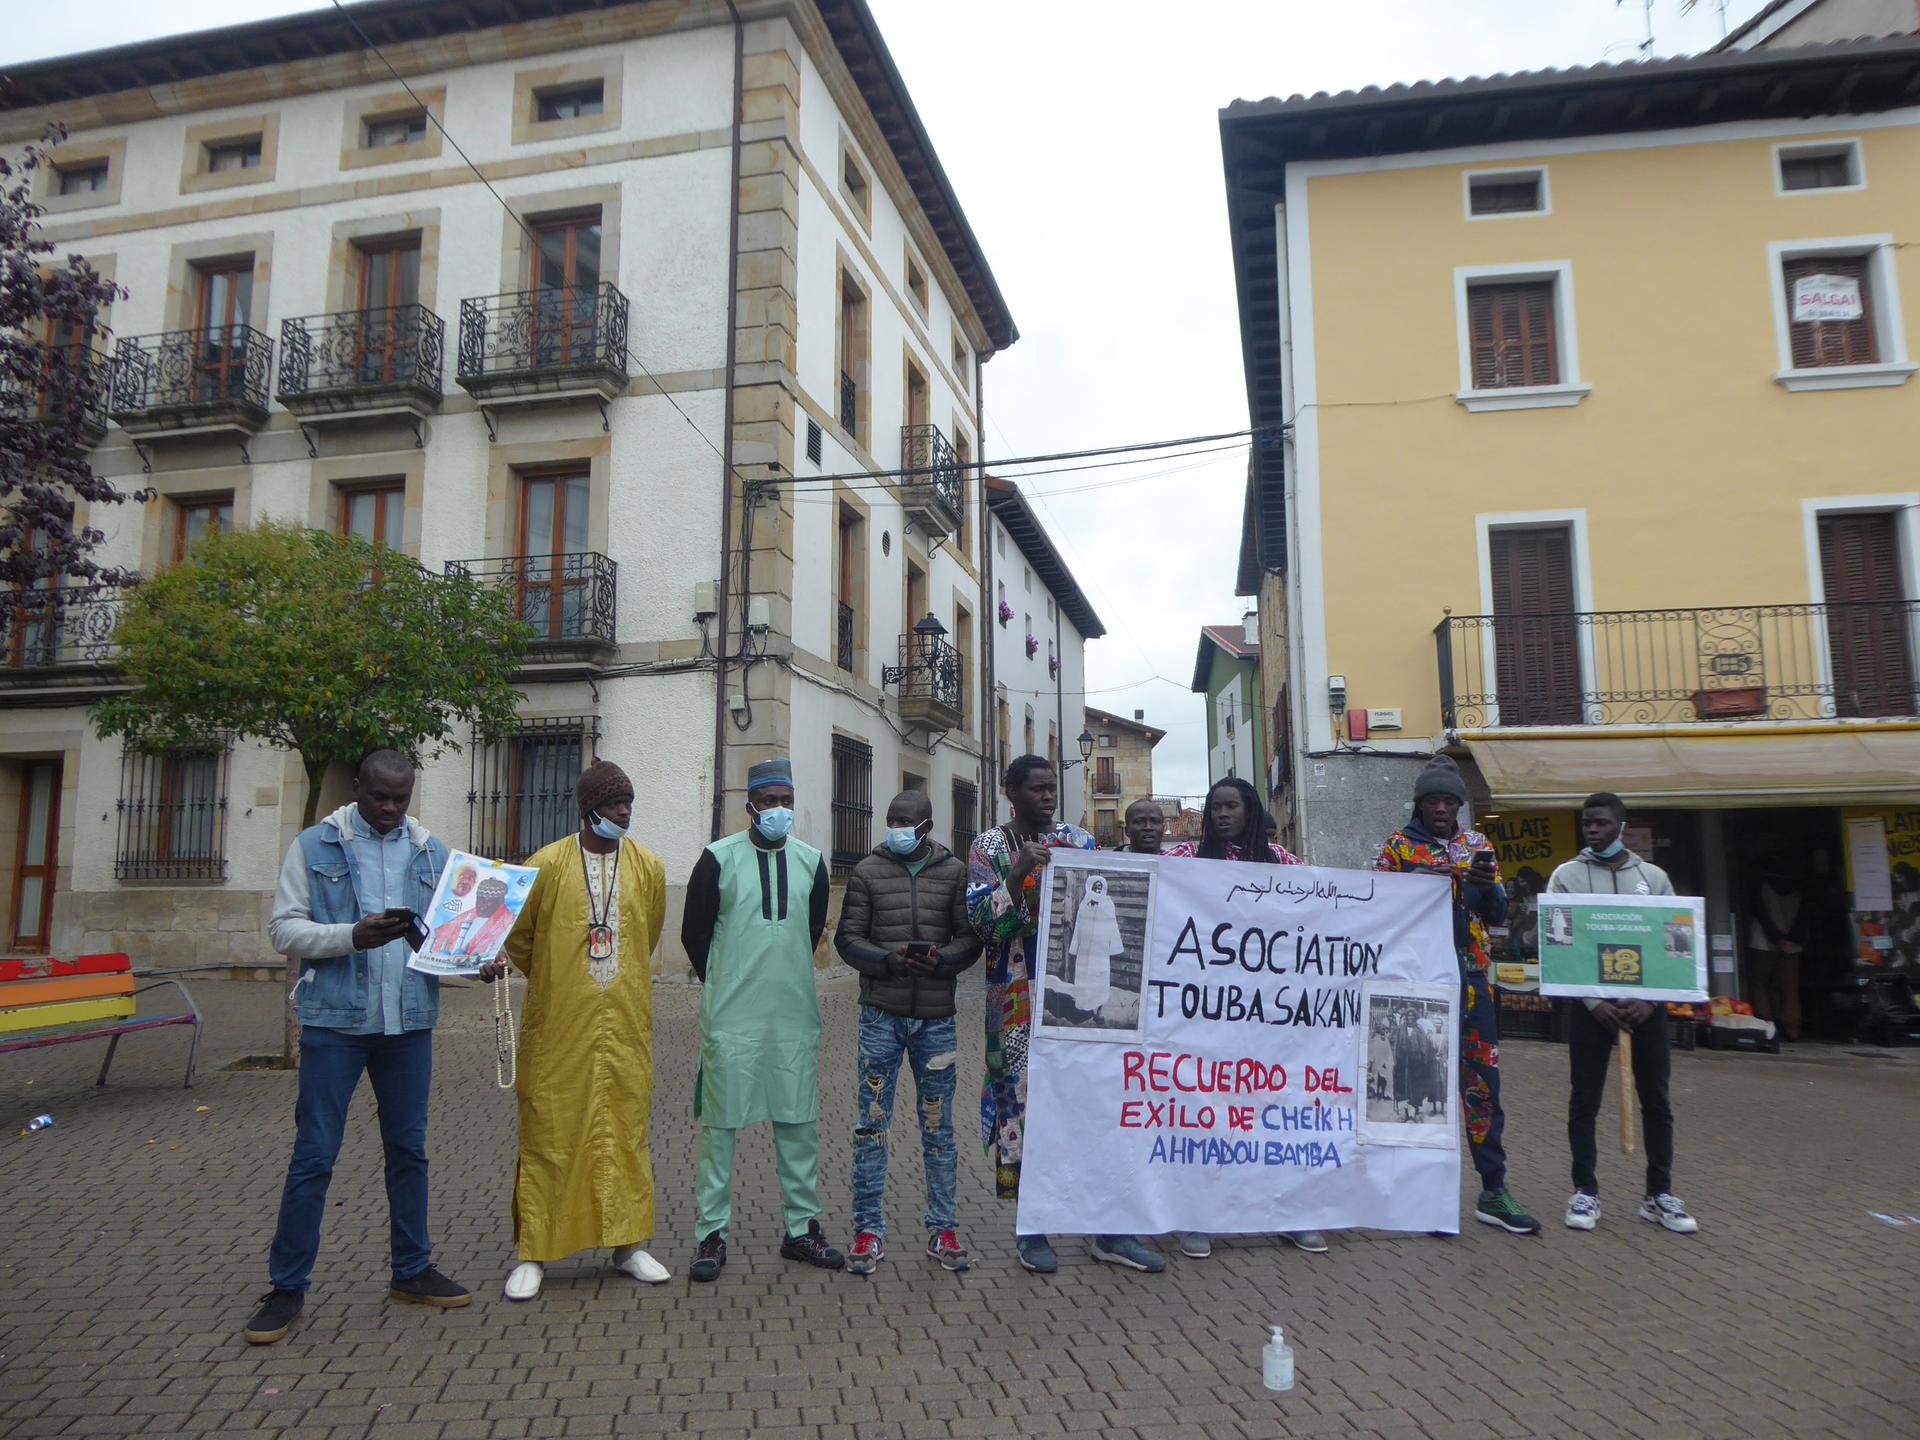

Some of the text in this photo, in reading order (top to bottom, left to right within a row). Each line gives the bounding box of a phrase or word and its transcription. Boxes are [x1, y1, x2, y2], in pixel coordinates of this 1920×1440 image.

[1123, 1051, 1353, 1094] RECUERDO DEL
[1228, 1105, 1255, 1132] DE
[1149, 1134, 1342, 1169] AHMADOU BAMBA
